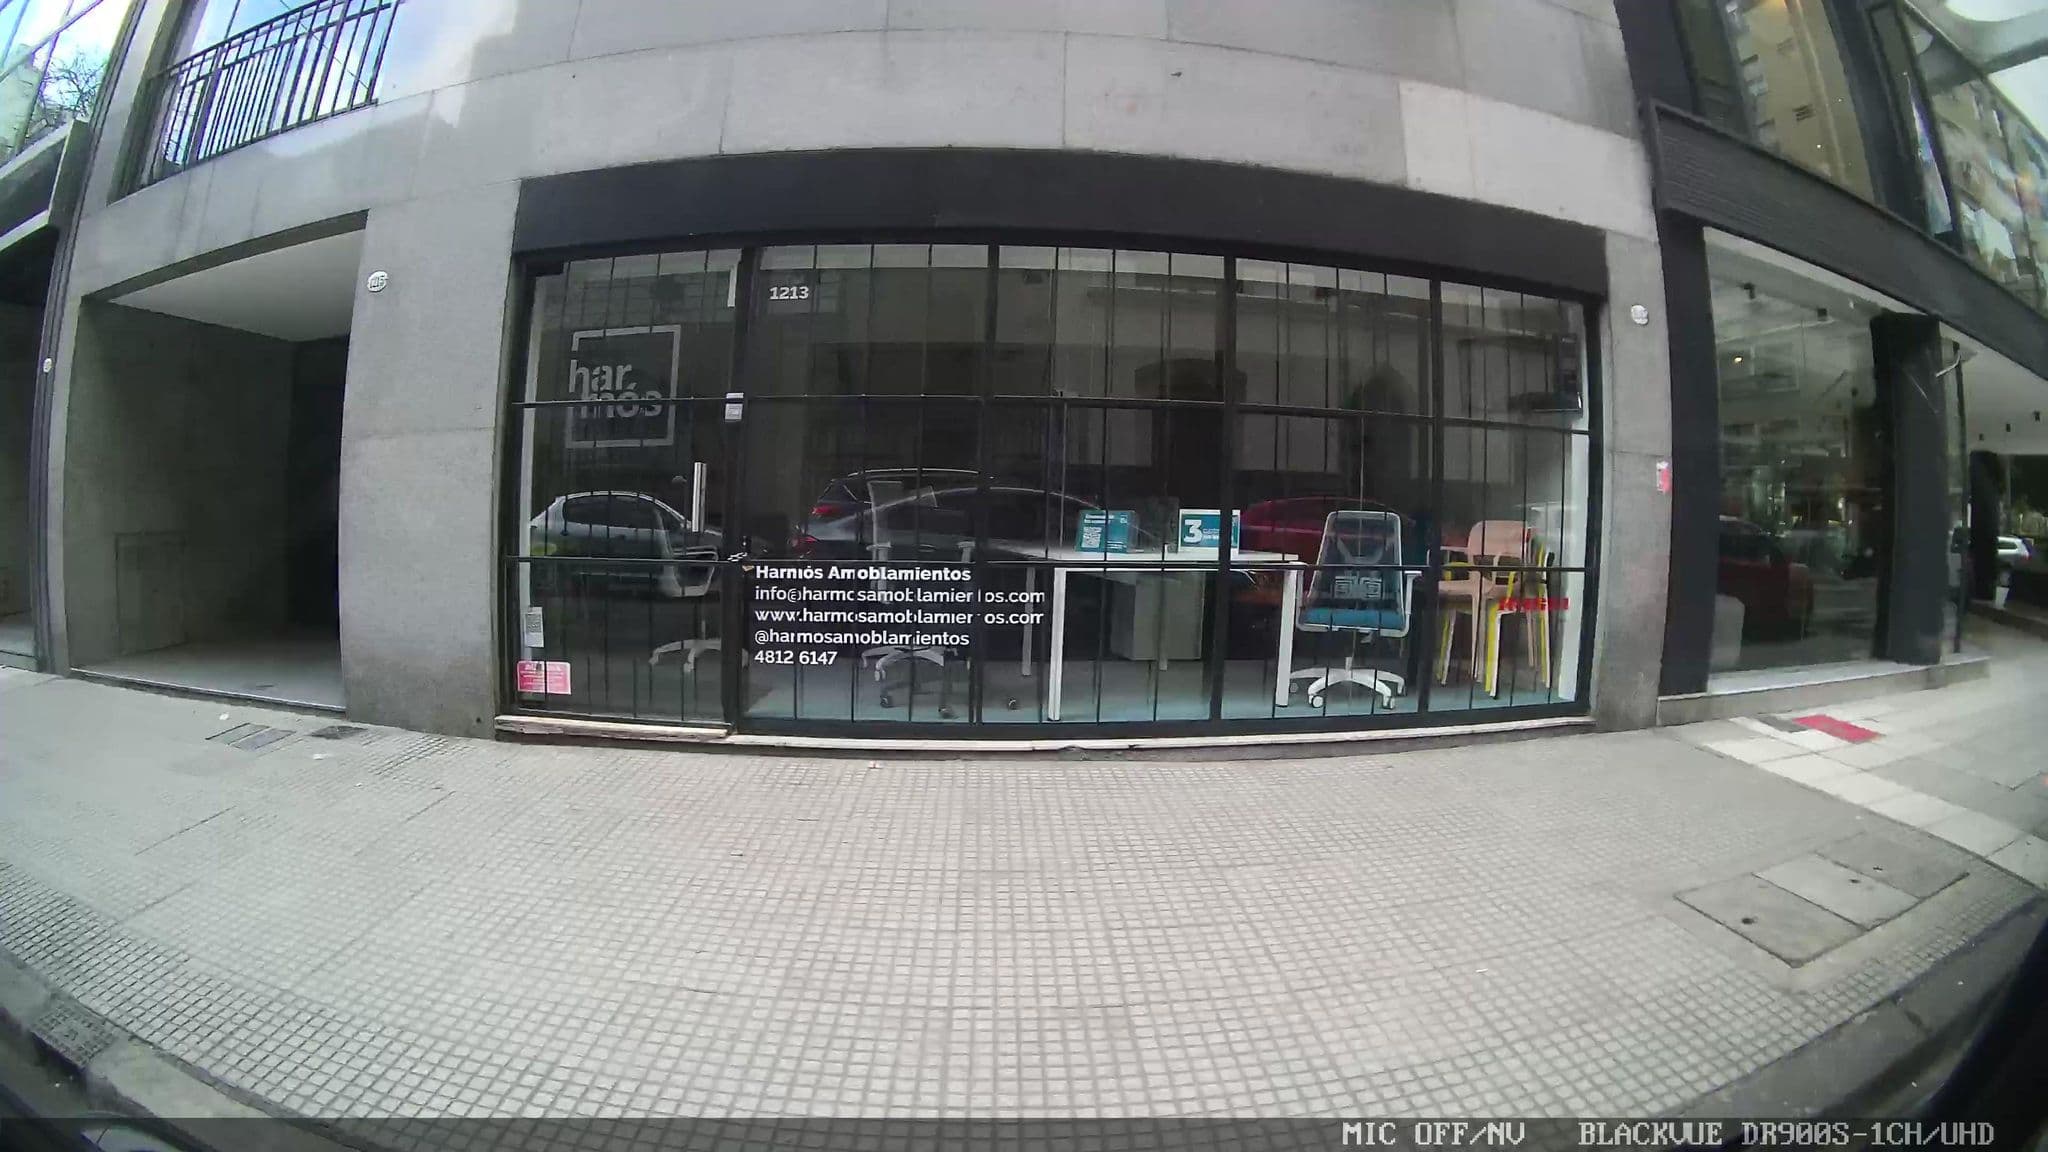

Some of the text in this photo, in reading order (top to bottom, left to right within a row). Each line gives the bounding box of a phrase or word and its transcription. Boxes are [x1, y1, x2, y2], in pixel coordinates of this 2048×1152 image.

[769, 286, 810, 300] 1213
[569, 359, 633, 393] har
[1183, 519, 1203, 543] 3
[755, 565, 972, 581] Harmós Amoblamientos
[754, 607, 1046, 624] www.harmosamoblamienos.com
[754, 628, 971, 645] @harmosamoblamientos
[754, 650, 839, 666] 4812 6147
